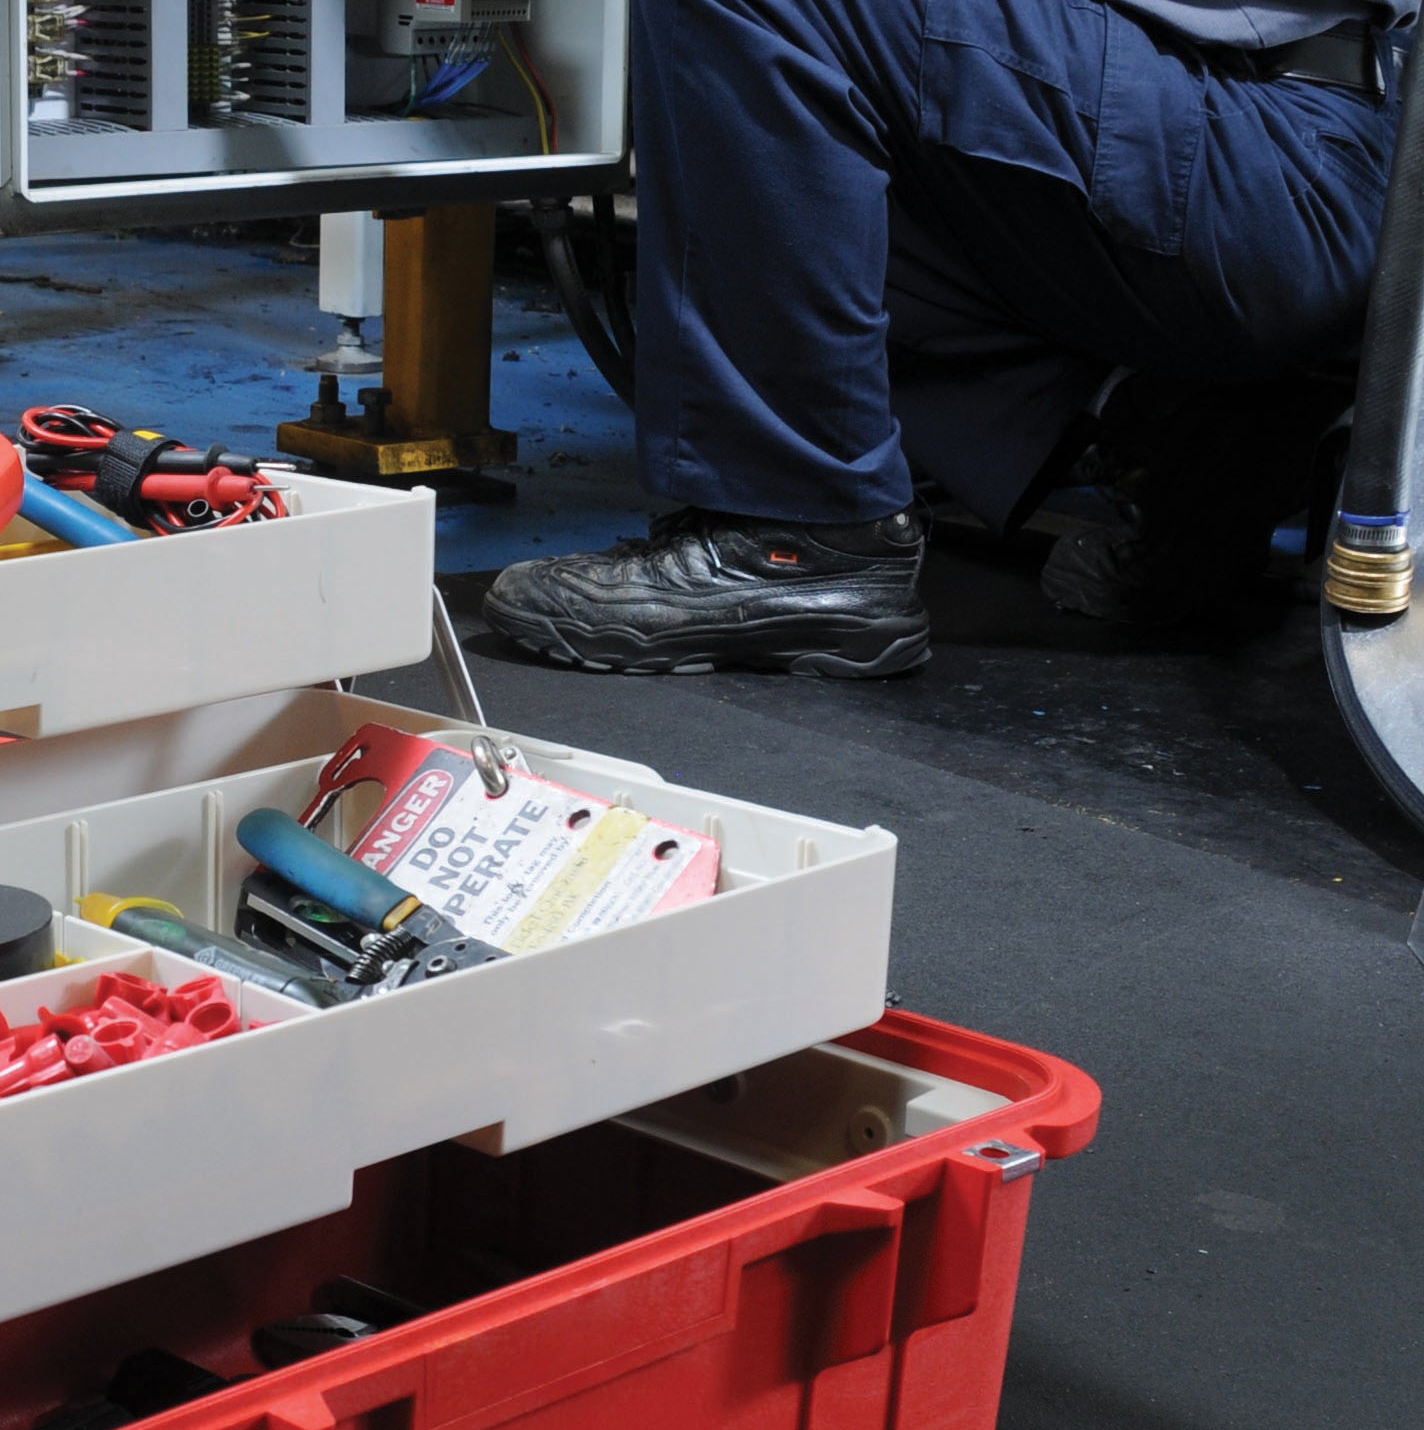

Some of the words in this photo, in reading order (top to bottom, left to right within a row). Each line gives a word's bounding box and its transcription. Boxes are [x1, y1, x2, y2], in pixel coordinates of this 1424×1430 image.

[360, 774, 448, 870] ANGER
[409, 827, 456, 872] DO
[429, 826, 488, 890] NOT
[442, 800, 549, 919] PERATE
